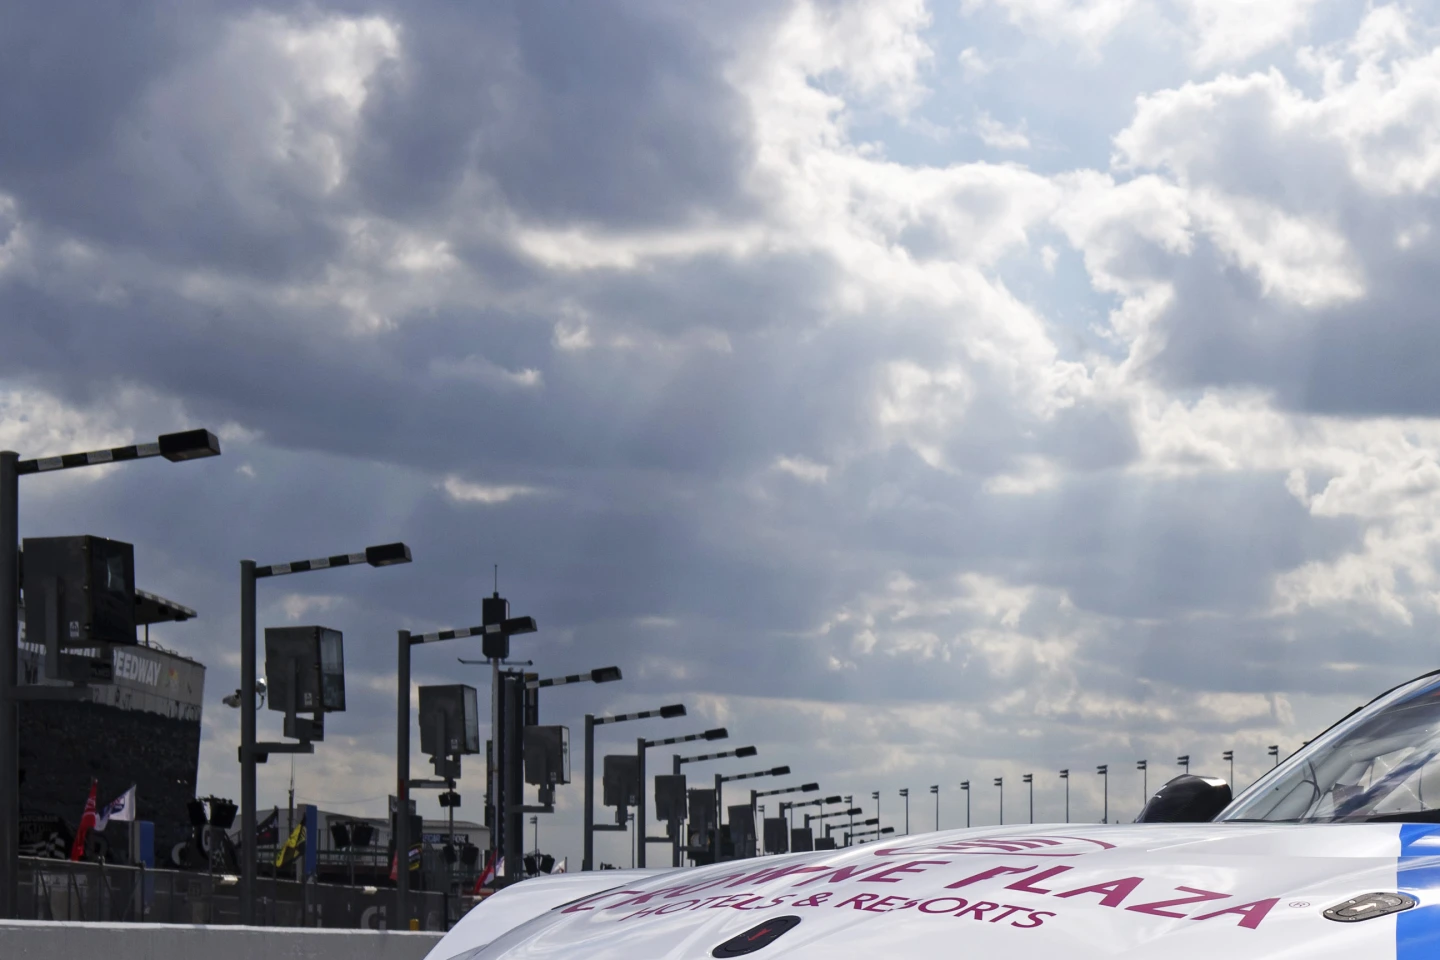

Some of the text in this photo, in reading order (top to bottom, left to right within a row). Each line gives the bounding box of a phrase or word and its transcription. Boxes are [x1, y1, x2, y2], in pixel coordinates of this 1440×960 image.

[114, 649, 162, 687] EEDWAY
[619, 891, 1057, 929] HOTELS & RESORTS
[943, 864, 1281, 930] PLAZA
